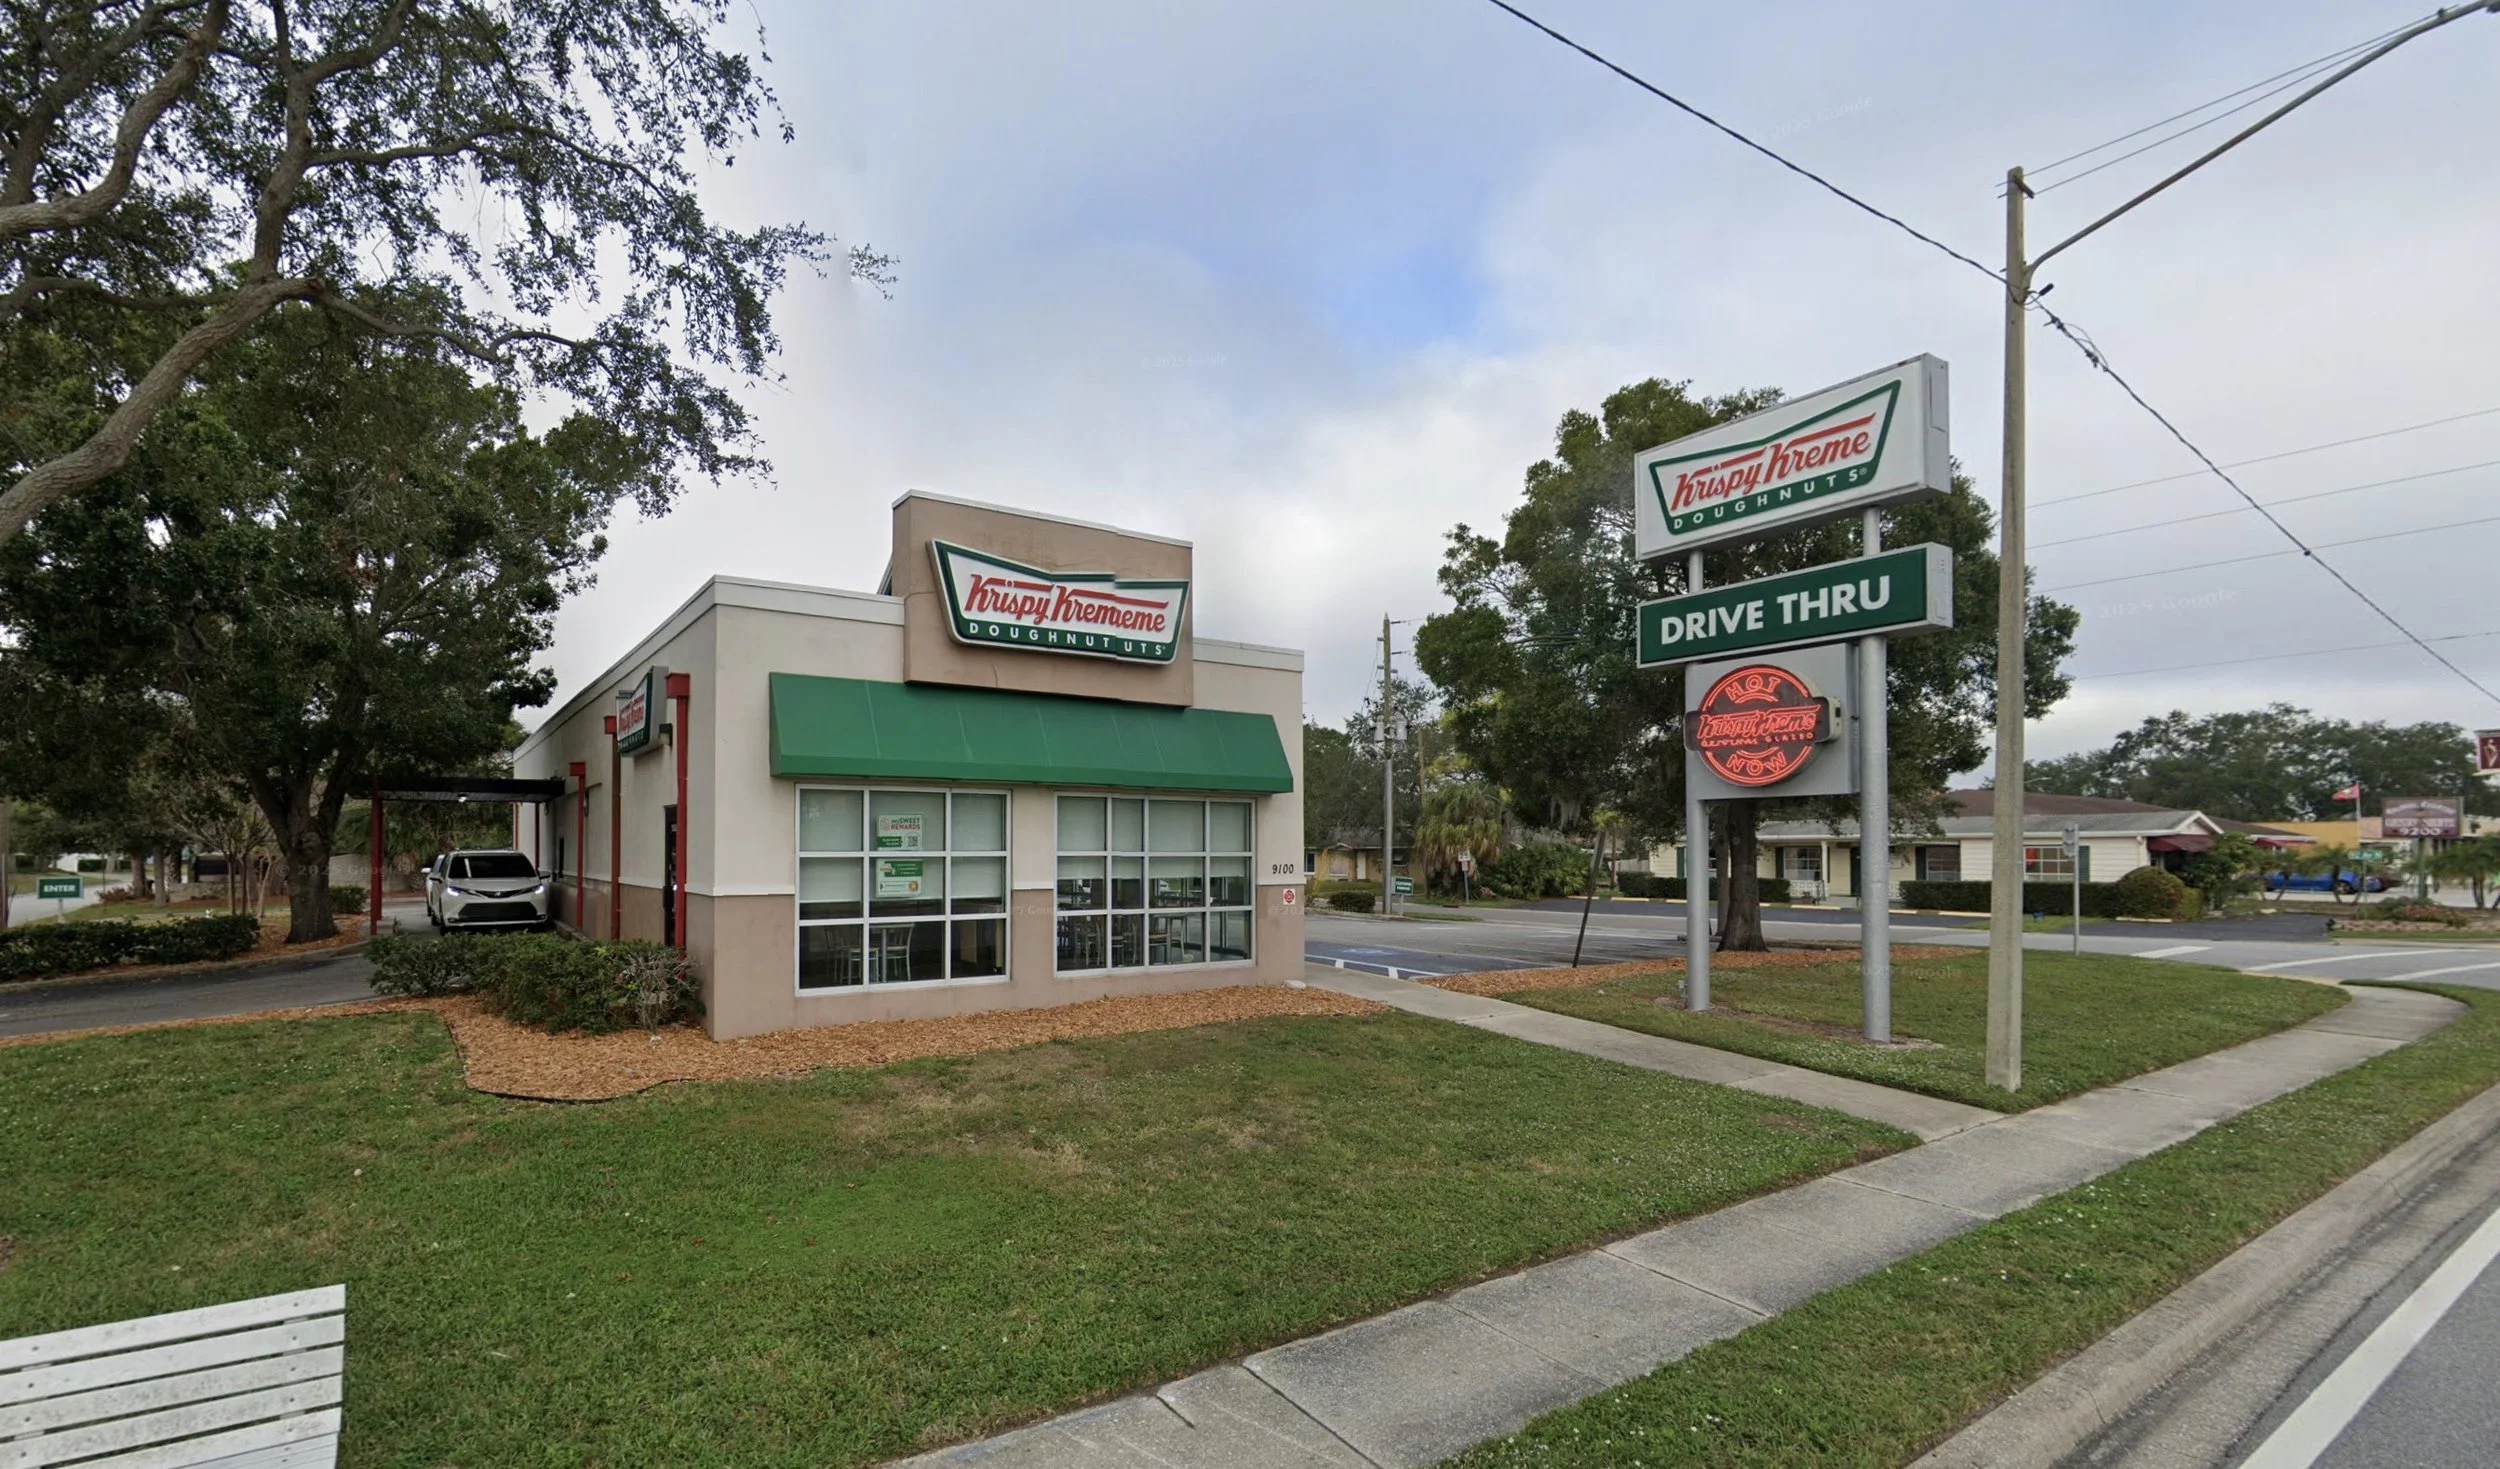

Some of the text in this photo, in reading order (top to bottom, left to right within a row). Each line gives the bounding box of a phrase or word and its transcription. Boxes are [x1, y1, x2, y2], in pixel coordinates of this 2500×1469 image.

[1670, 412, 1878, 512] Krispy Kreme
[965, 573, 1055, 625] Krispy
[1661, 575, 1891, 646] DRIVE THRU
[1725, 674, 1780, 700] HOT
[1726, 751, 1787, 776] NOW
[2400, 827, 2441, 836] 9200
[1272, 863, 1295, 875] 9100
[43, 884, 77, 893] ENTER
